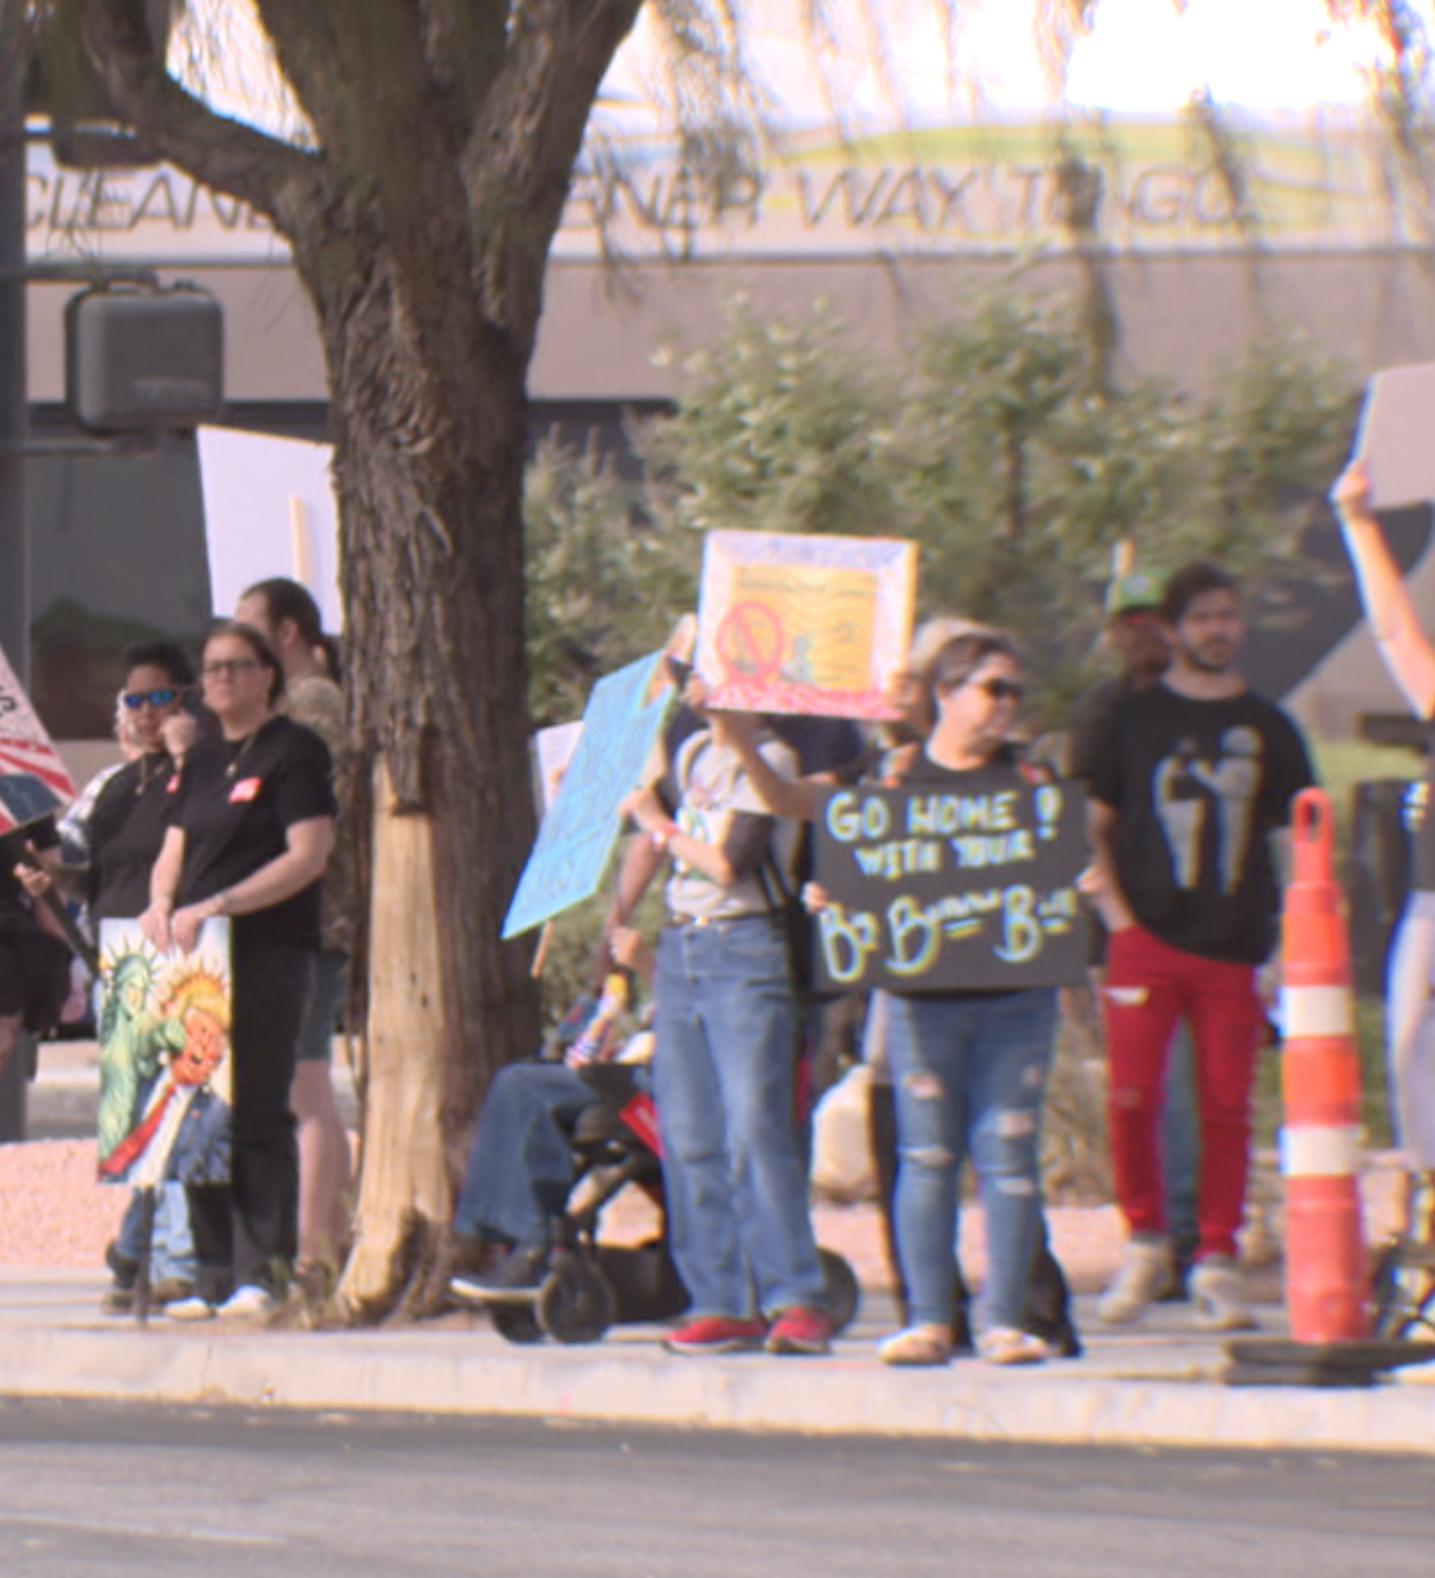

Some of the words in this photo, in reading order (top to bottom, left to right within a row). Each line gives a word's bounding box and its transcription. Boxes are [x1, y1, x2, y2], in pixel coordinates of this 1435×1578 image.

[797, 168, 978, 229] WAY
[827, 791, 890, 842] GO
[906, 790, 1018, 835] HOME
[853, 840, 941, 880] WITH
[950, 829, 1036, 868] YOUR
